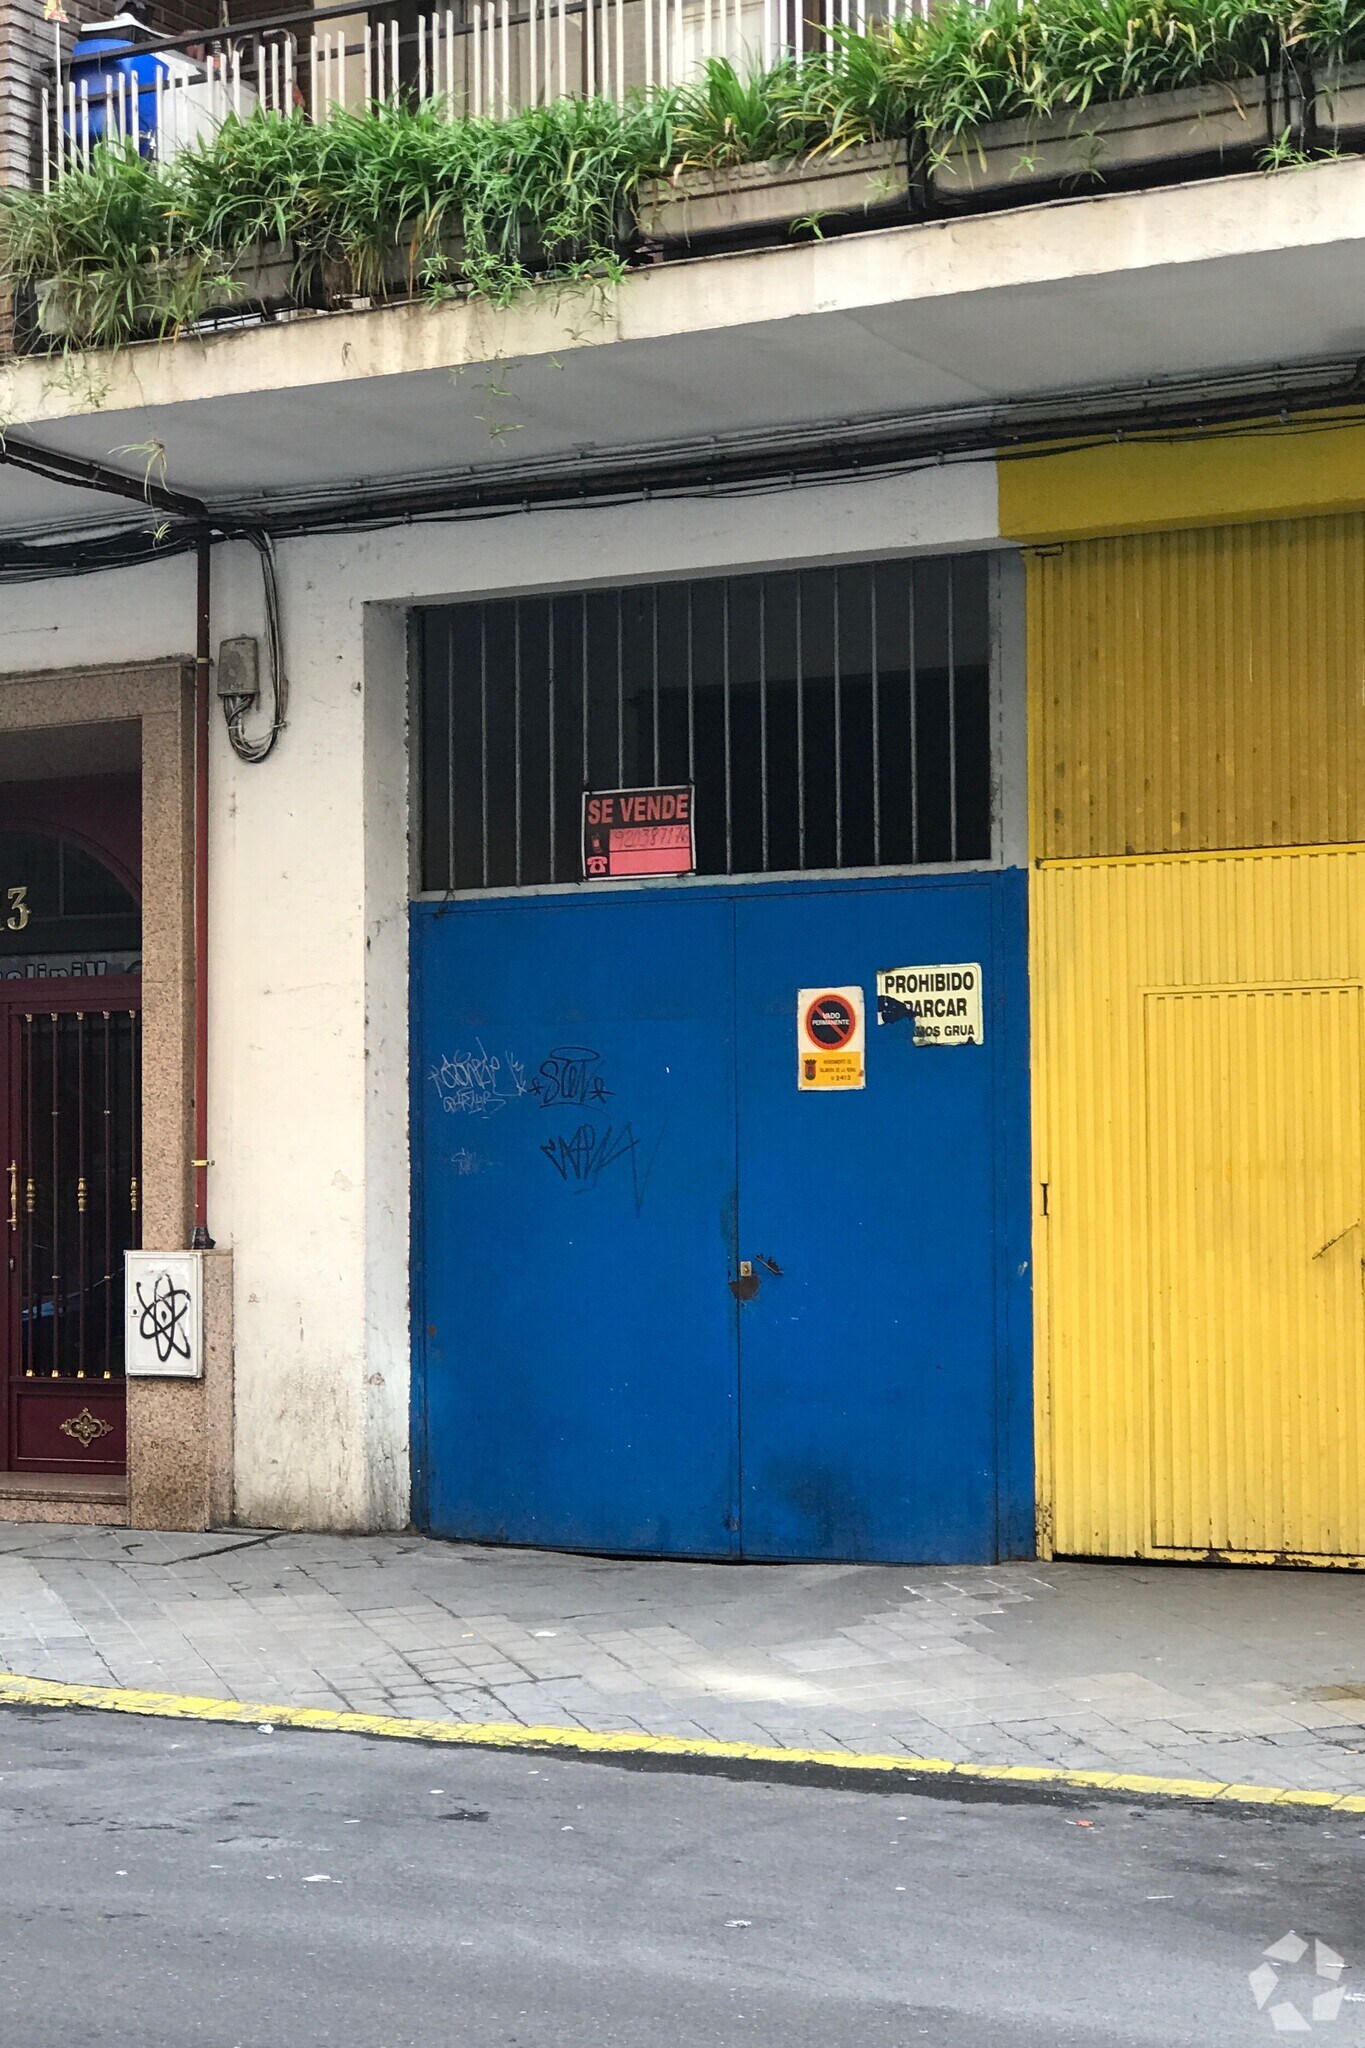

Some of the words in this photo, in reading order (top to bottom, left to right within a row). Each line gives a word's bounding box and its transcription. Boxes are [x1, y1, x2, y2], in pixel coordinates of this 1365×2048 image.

[588, 799, 613, 824] SE
[620, 794, 689, 822] VENDE
[885, 971, 974, 994] PROHIBIDO
[944, 1024, 975, 1037] GRUA
